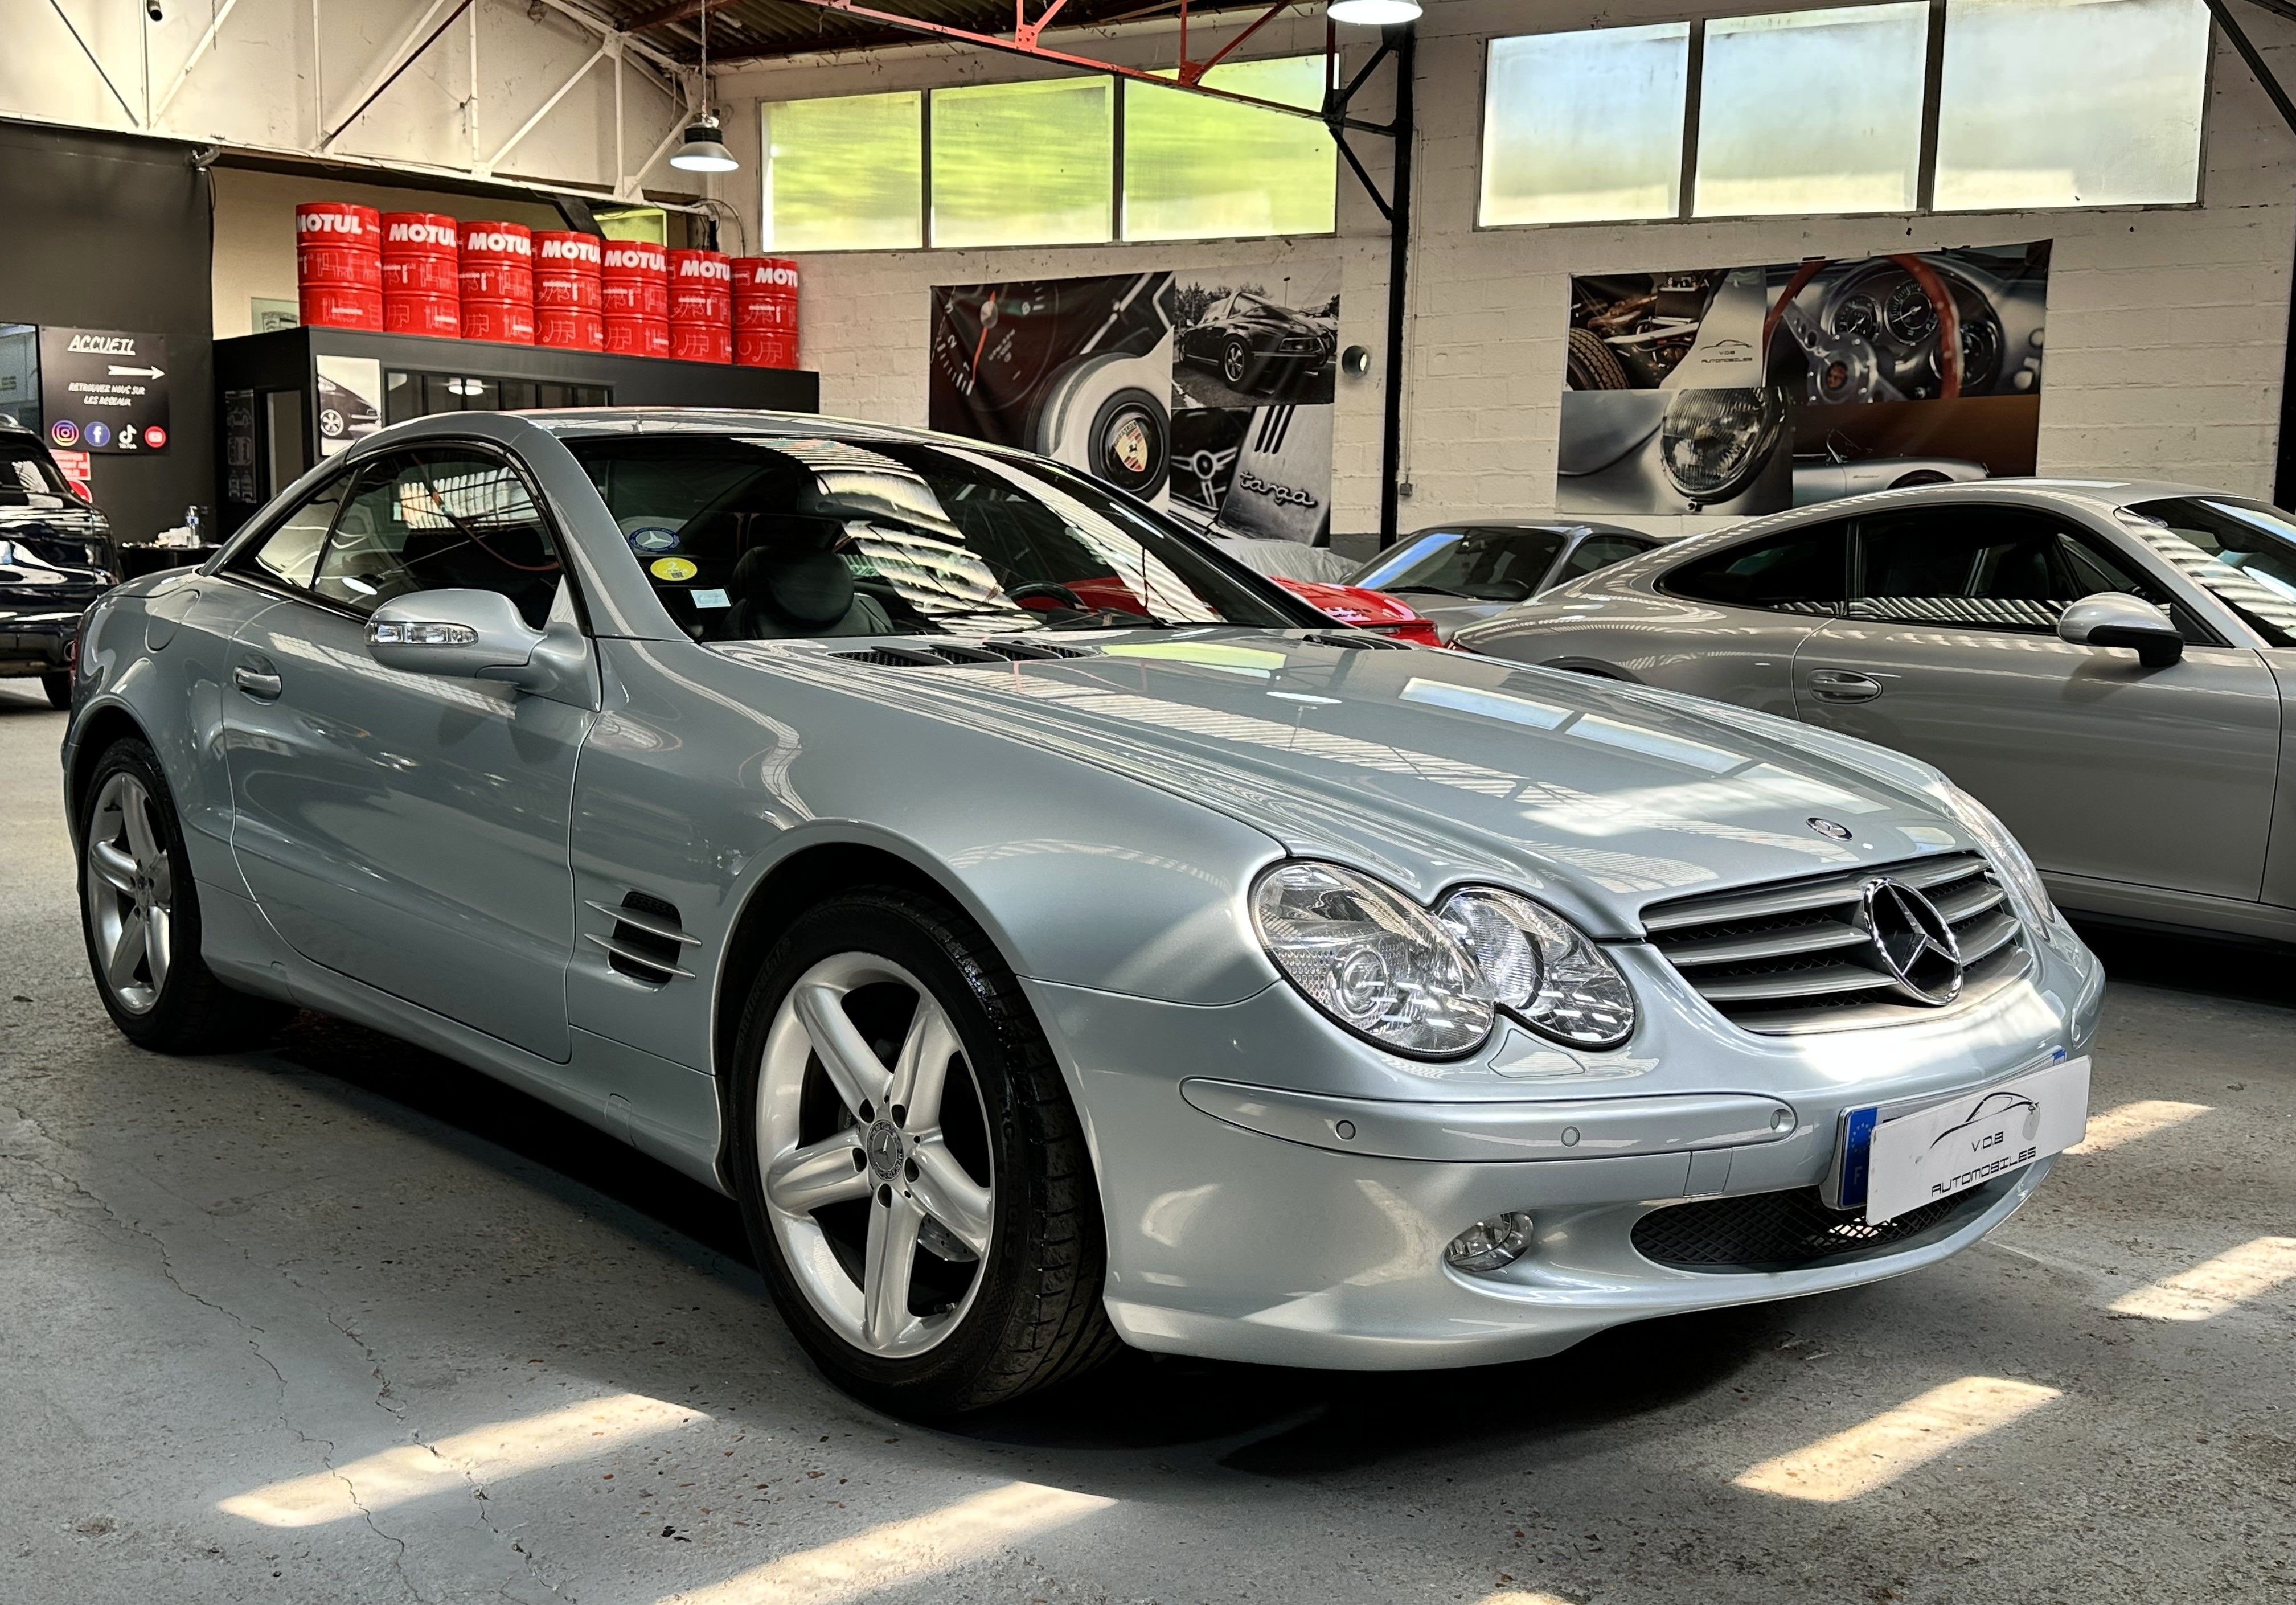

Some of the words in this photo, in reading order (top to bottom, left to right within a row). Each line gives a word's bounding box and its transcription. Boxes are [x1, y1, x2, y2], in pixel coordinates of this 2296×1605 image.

[604, 250, 666, 272] MOTUL
[68, 334, 136, 355] ACCUEIL
[84, 395, 99, 405] LES
[1239, 471, 1318, 508] targa
[1854, 1165, 1863, 1185] F
[1931, 1146, 2037, 1197] AUTOMOBILES
